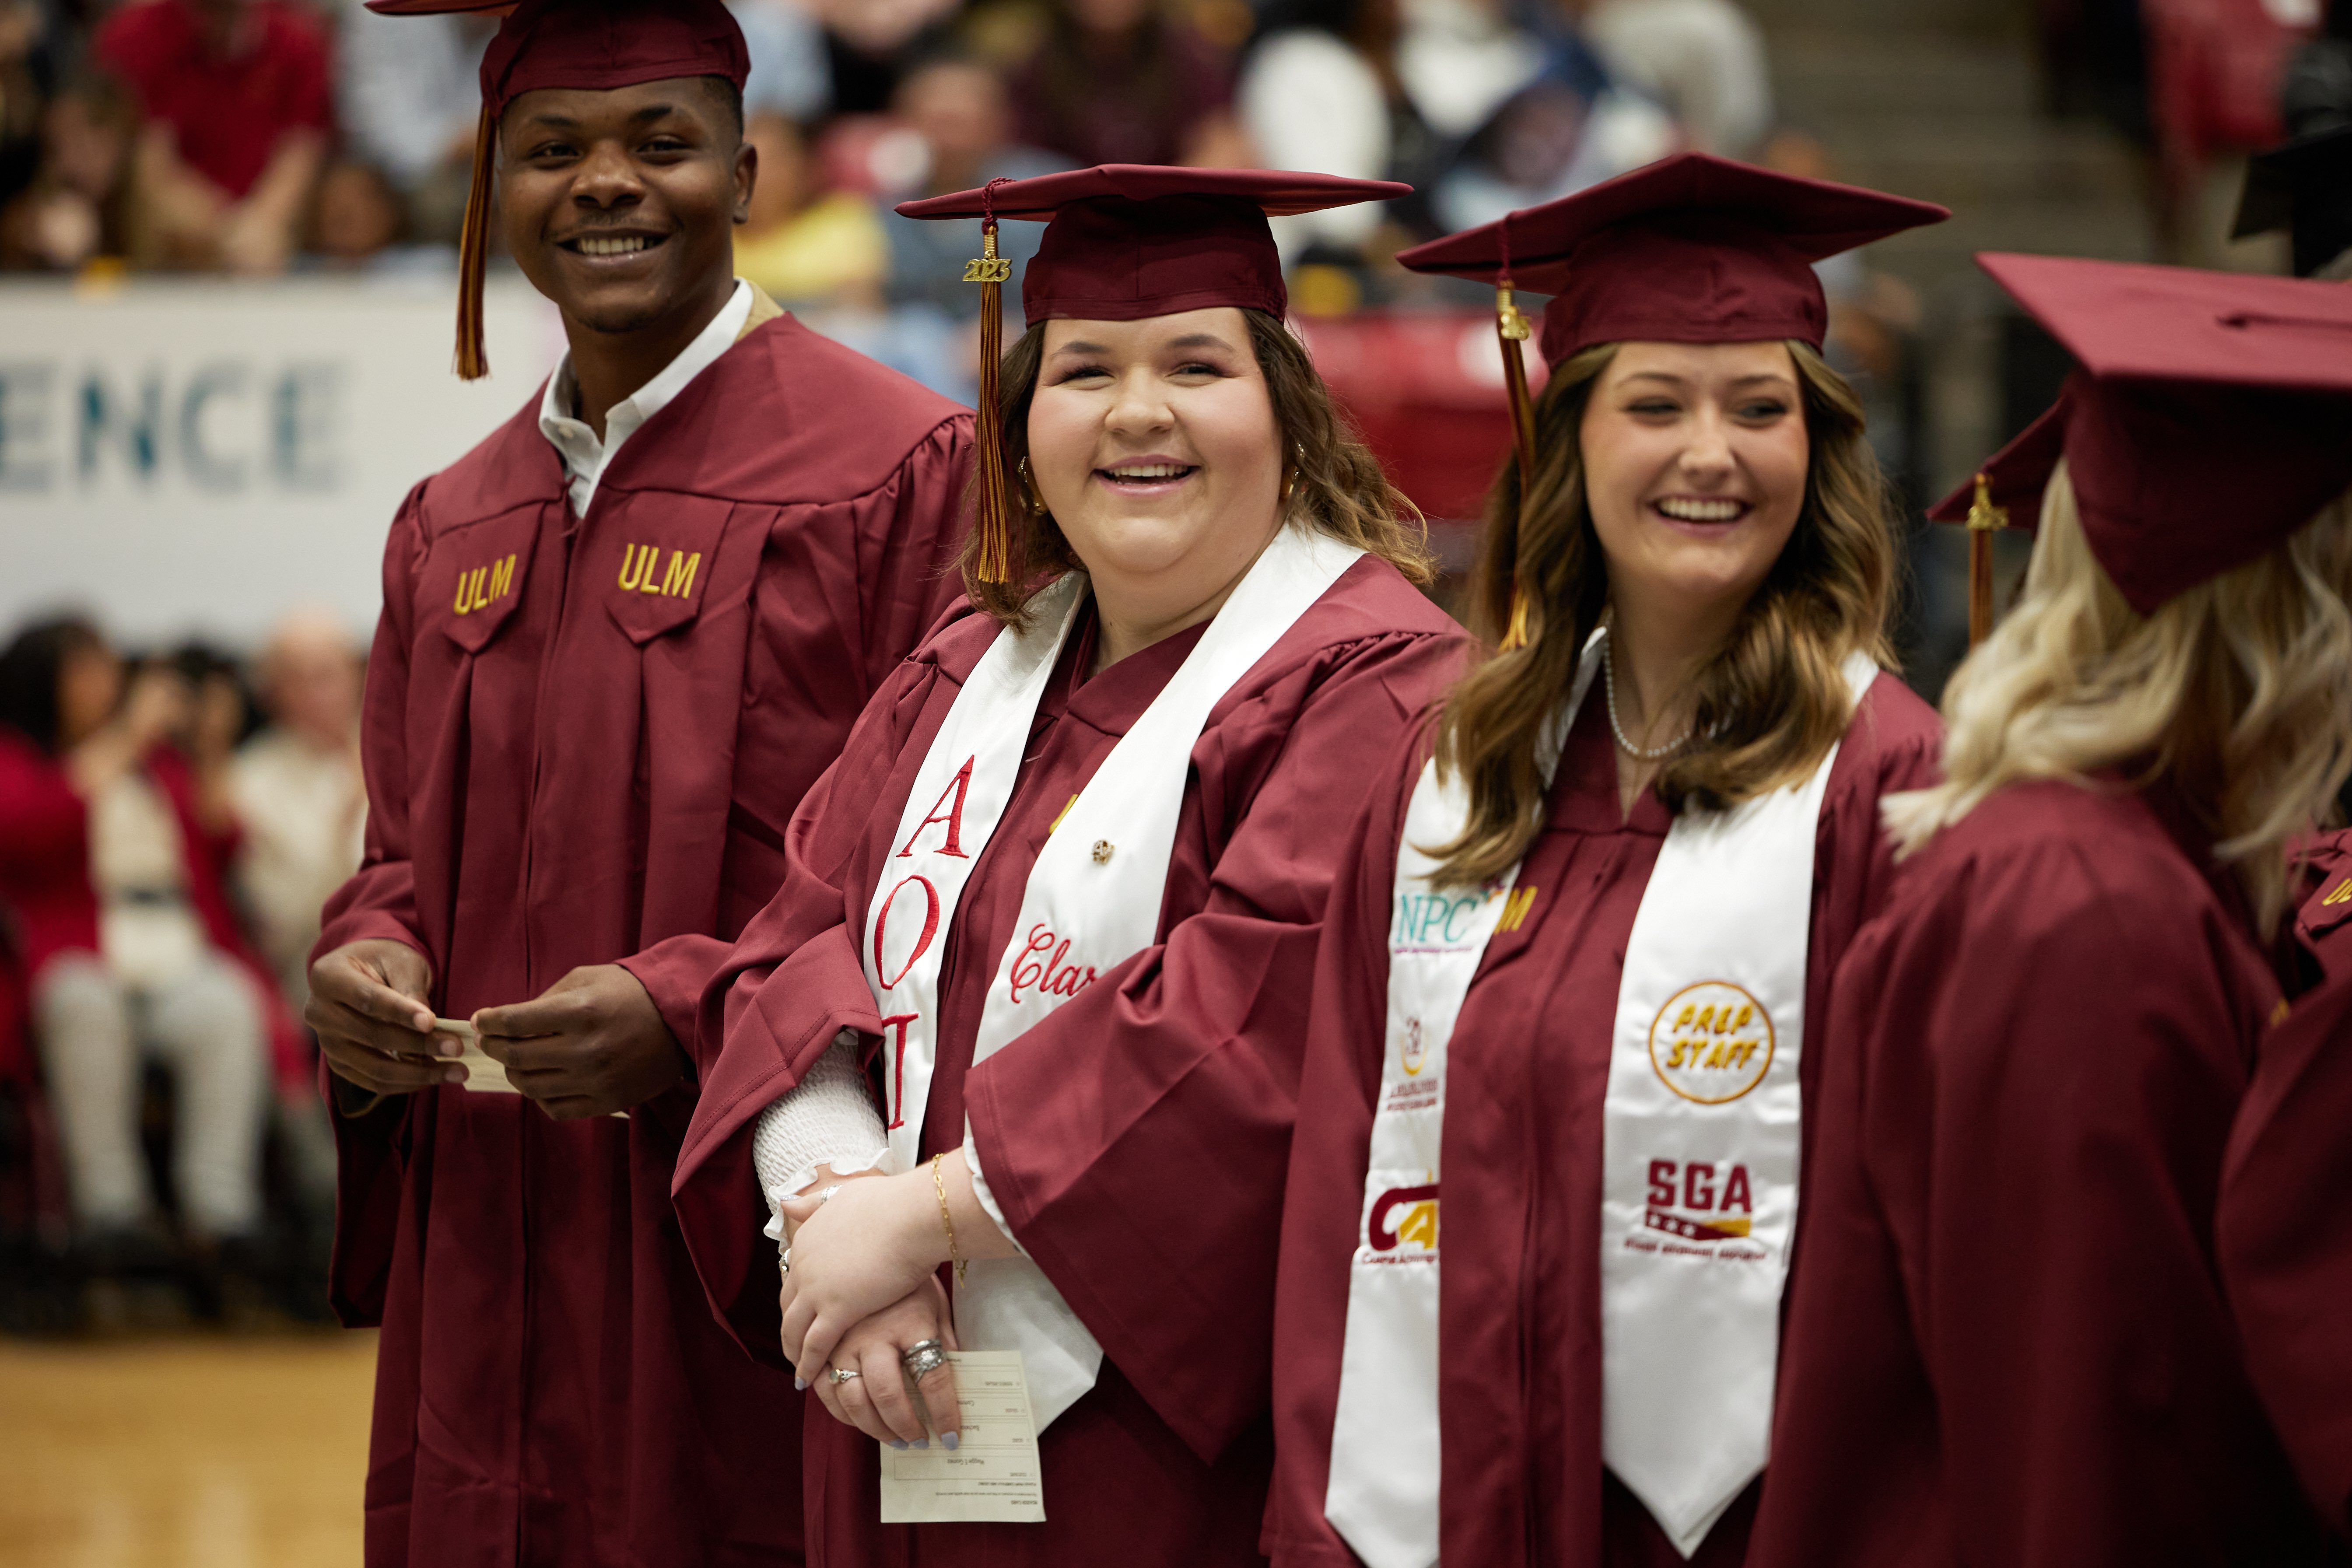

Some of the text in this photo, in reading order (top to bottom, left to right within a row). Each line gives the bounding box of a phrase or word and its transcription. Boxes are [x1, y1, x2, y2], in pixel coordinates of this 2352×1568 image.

[962, 259, 1012, 282] 2023
[453, 553, 517, 615] ULM
[617, 543, 701, 599] ULM
[1396, 893, 1477, 943] NPC
[1666, 1037, 1758, 1070] STAFF
[1646, 1157, 1753, 1214] SGA
